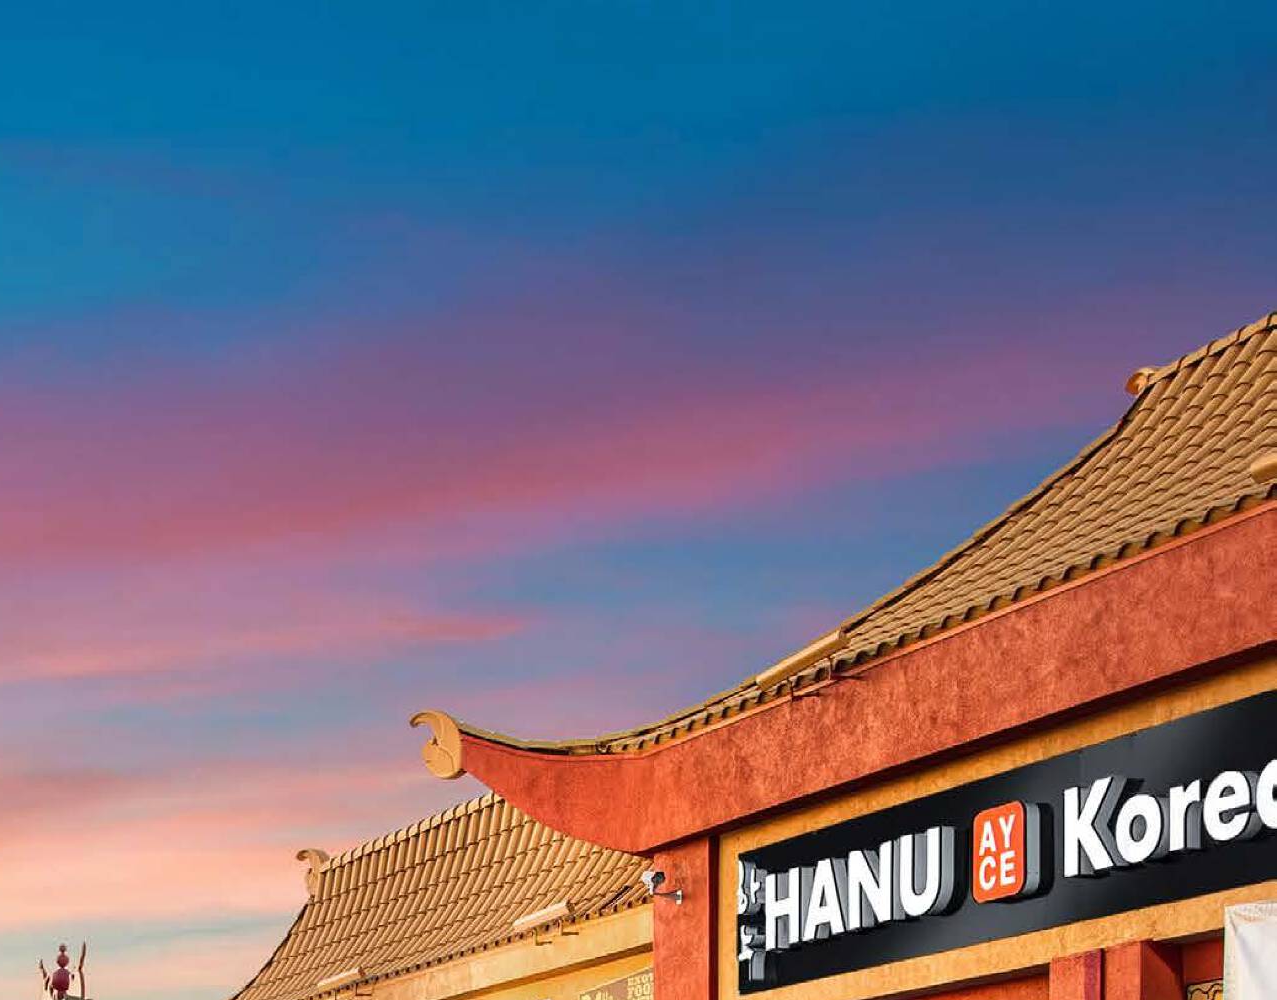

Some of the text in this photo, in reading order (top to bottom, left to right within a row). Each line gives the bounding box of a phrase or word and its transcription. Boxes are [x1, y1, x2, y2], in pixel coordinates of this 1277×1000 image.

[765, 826, 940, 950] HANU
[979, 813, 1016, 857] AY
[979, 850, 1016, 890] CE
